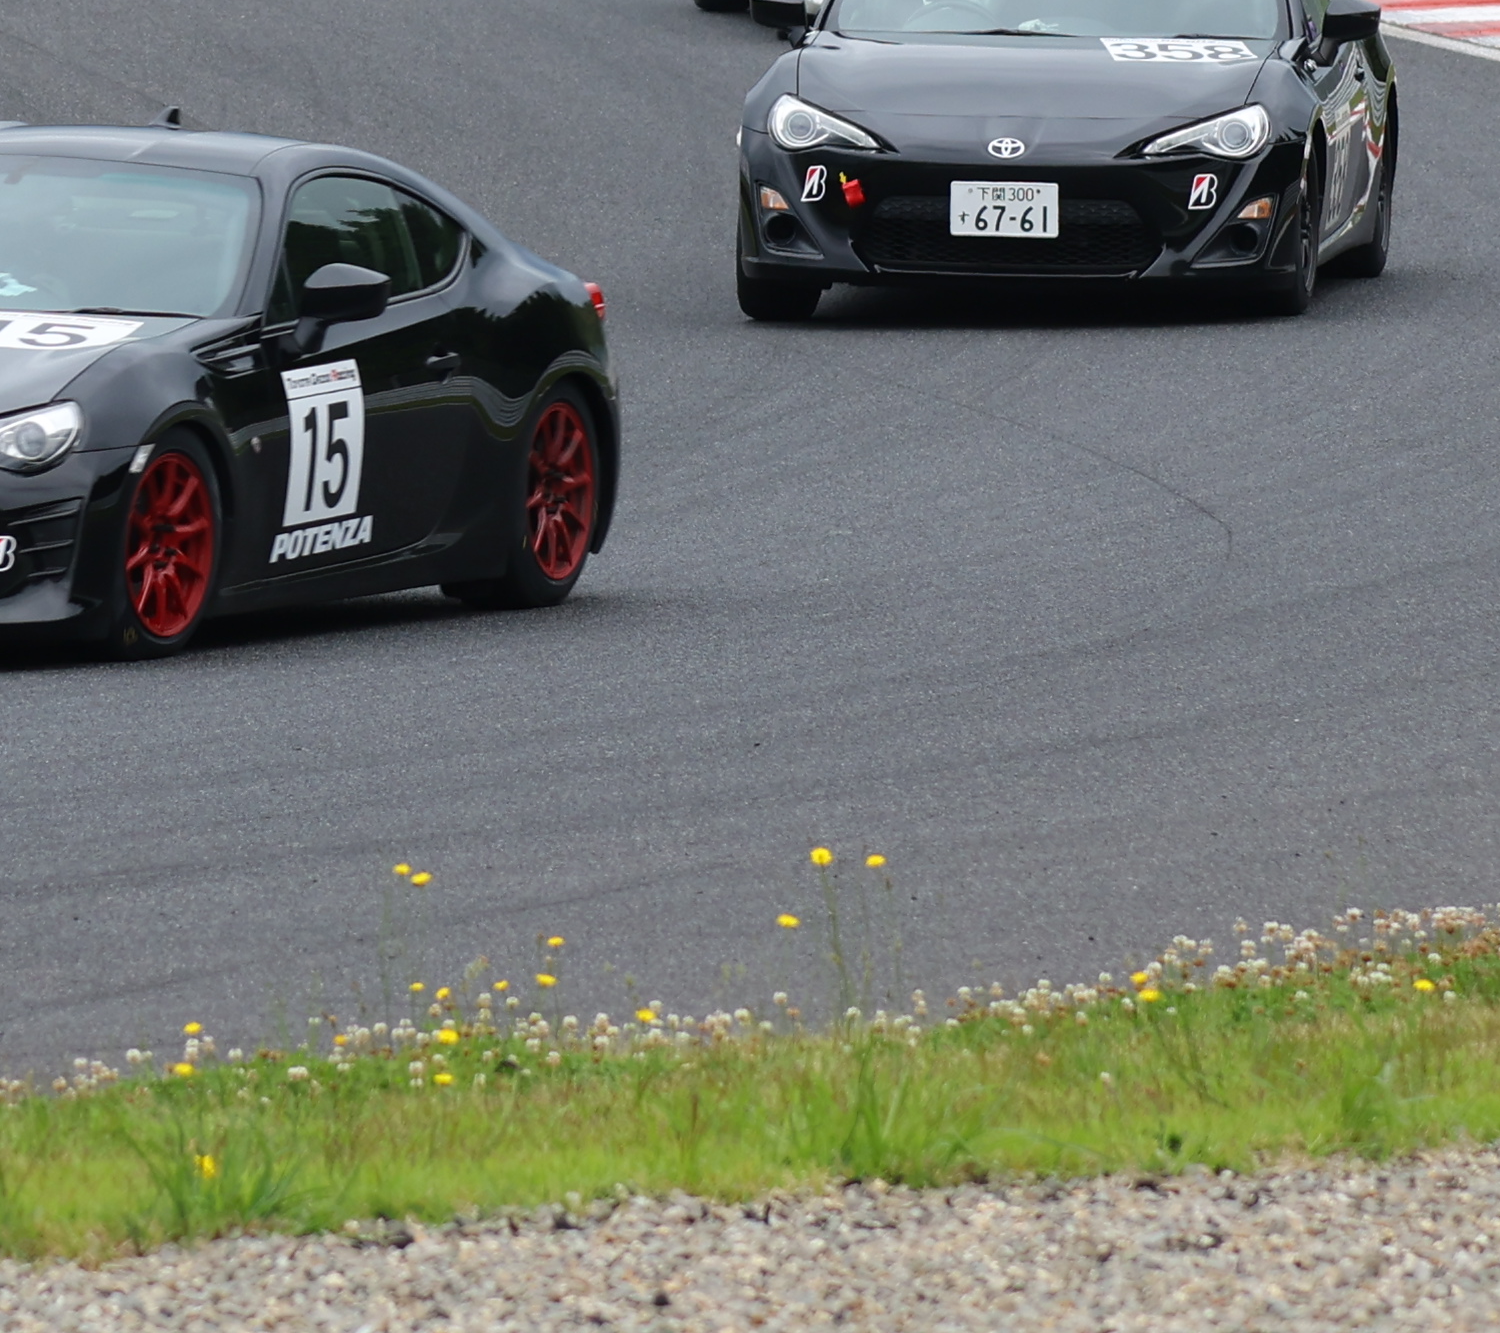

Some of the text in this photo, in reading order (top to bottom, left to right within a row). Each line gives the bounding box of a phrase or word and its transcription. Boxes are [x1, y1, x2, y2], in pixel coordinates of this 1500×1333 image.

[1109, 42, 1252, 61] 358
[976, 187, 1035, 202] 下関 300
[974, 204, 1048, 233] 67-61
[303, 400, 349, 512] 15
[269, 515, 373, 563] POTENZA
